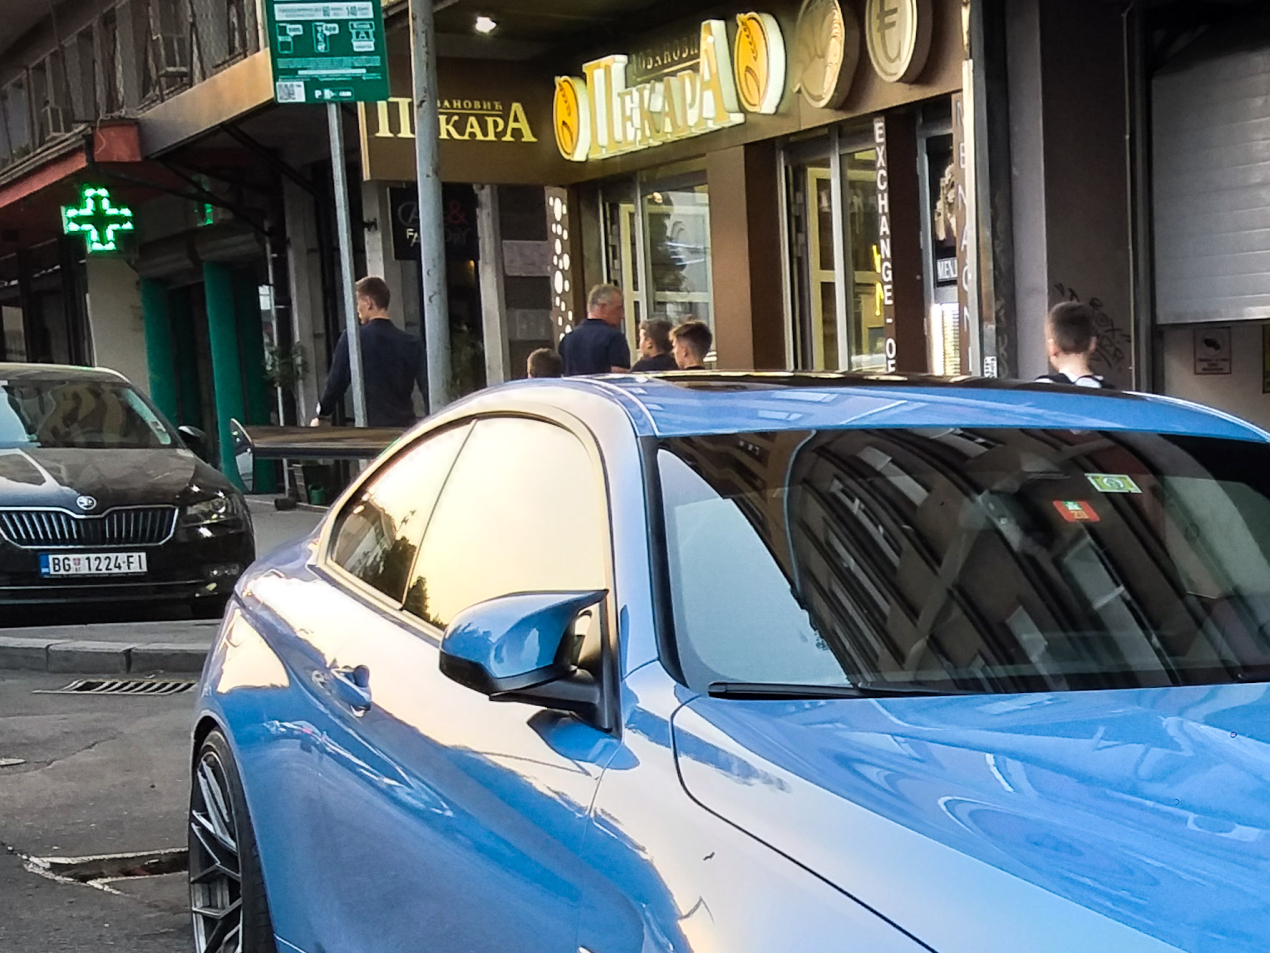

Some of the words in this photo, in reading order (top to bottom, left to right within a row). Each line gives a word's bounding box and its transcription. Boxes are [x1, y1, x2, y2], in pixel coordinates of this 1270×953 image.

[375, 98, 538, 142] ПКАРА
[583, 19, 745, 159] ПЕКАРА
[874, 122, 894, 305] EXCHANGE
[52, 557, 71, 573] BG
